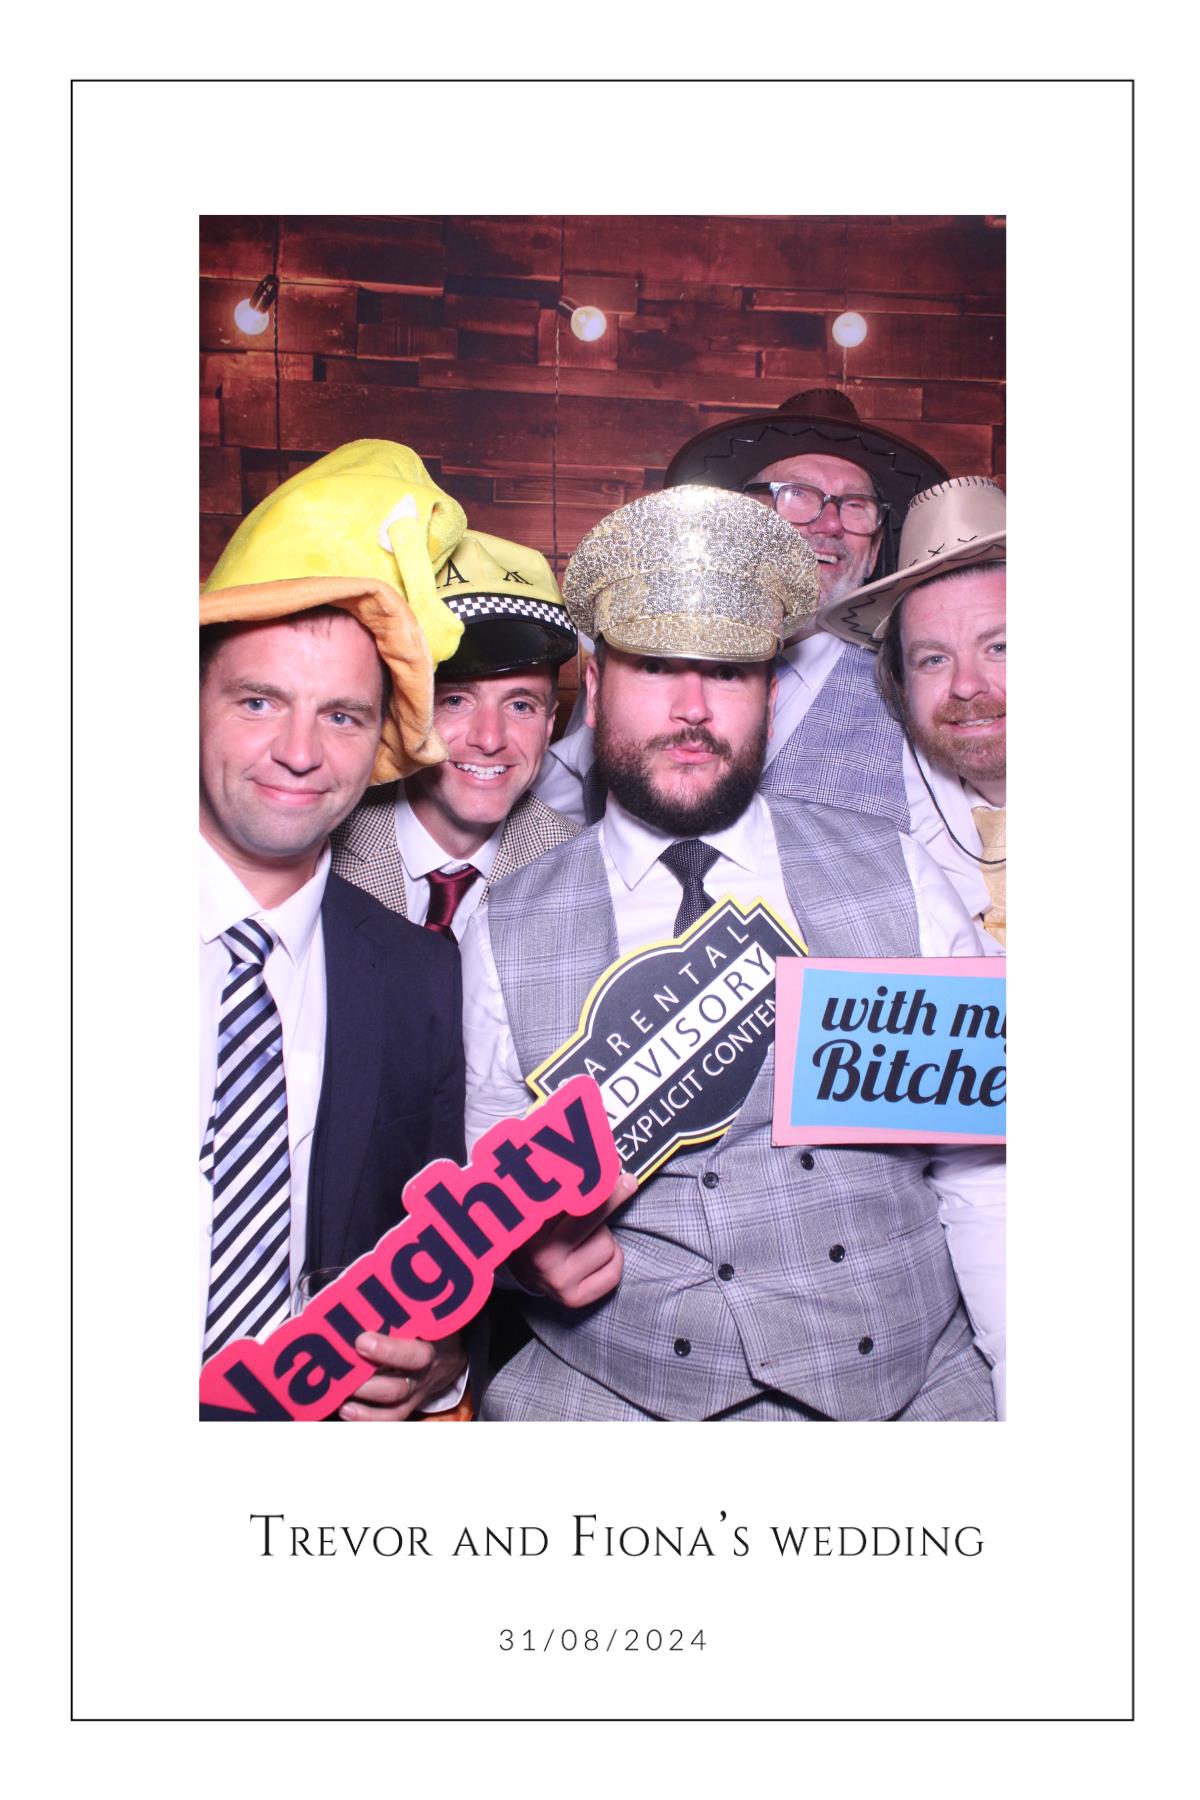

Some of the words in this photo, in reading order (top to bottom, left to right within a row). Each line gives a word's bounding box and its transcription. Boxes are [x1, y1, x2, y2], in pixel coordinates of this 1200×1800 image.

[558, 925, 750, 1088] ARENTAL
[820, 985, 938, 1037] with
[949, 1003, 1007, 1053] m
[811, 1038, 1007, 1108] Bitche
[614, 1069, 705, 1162] EXPLICIT
